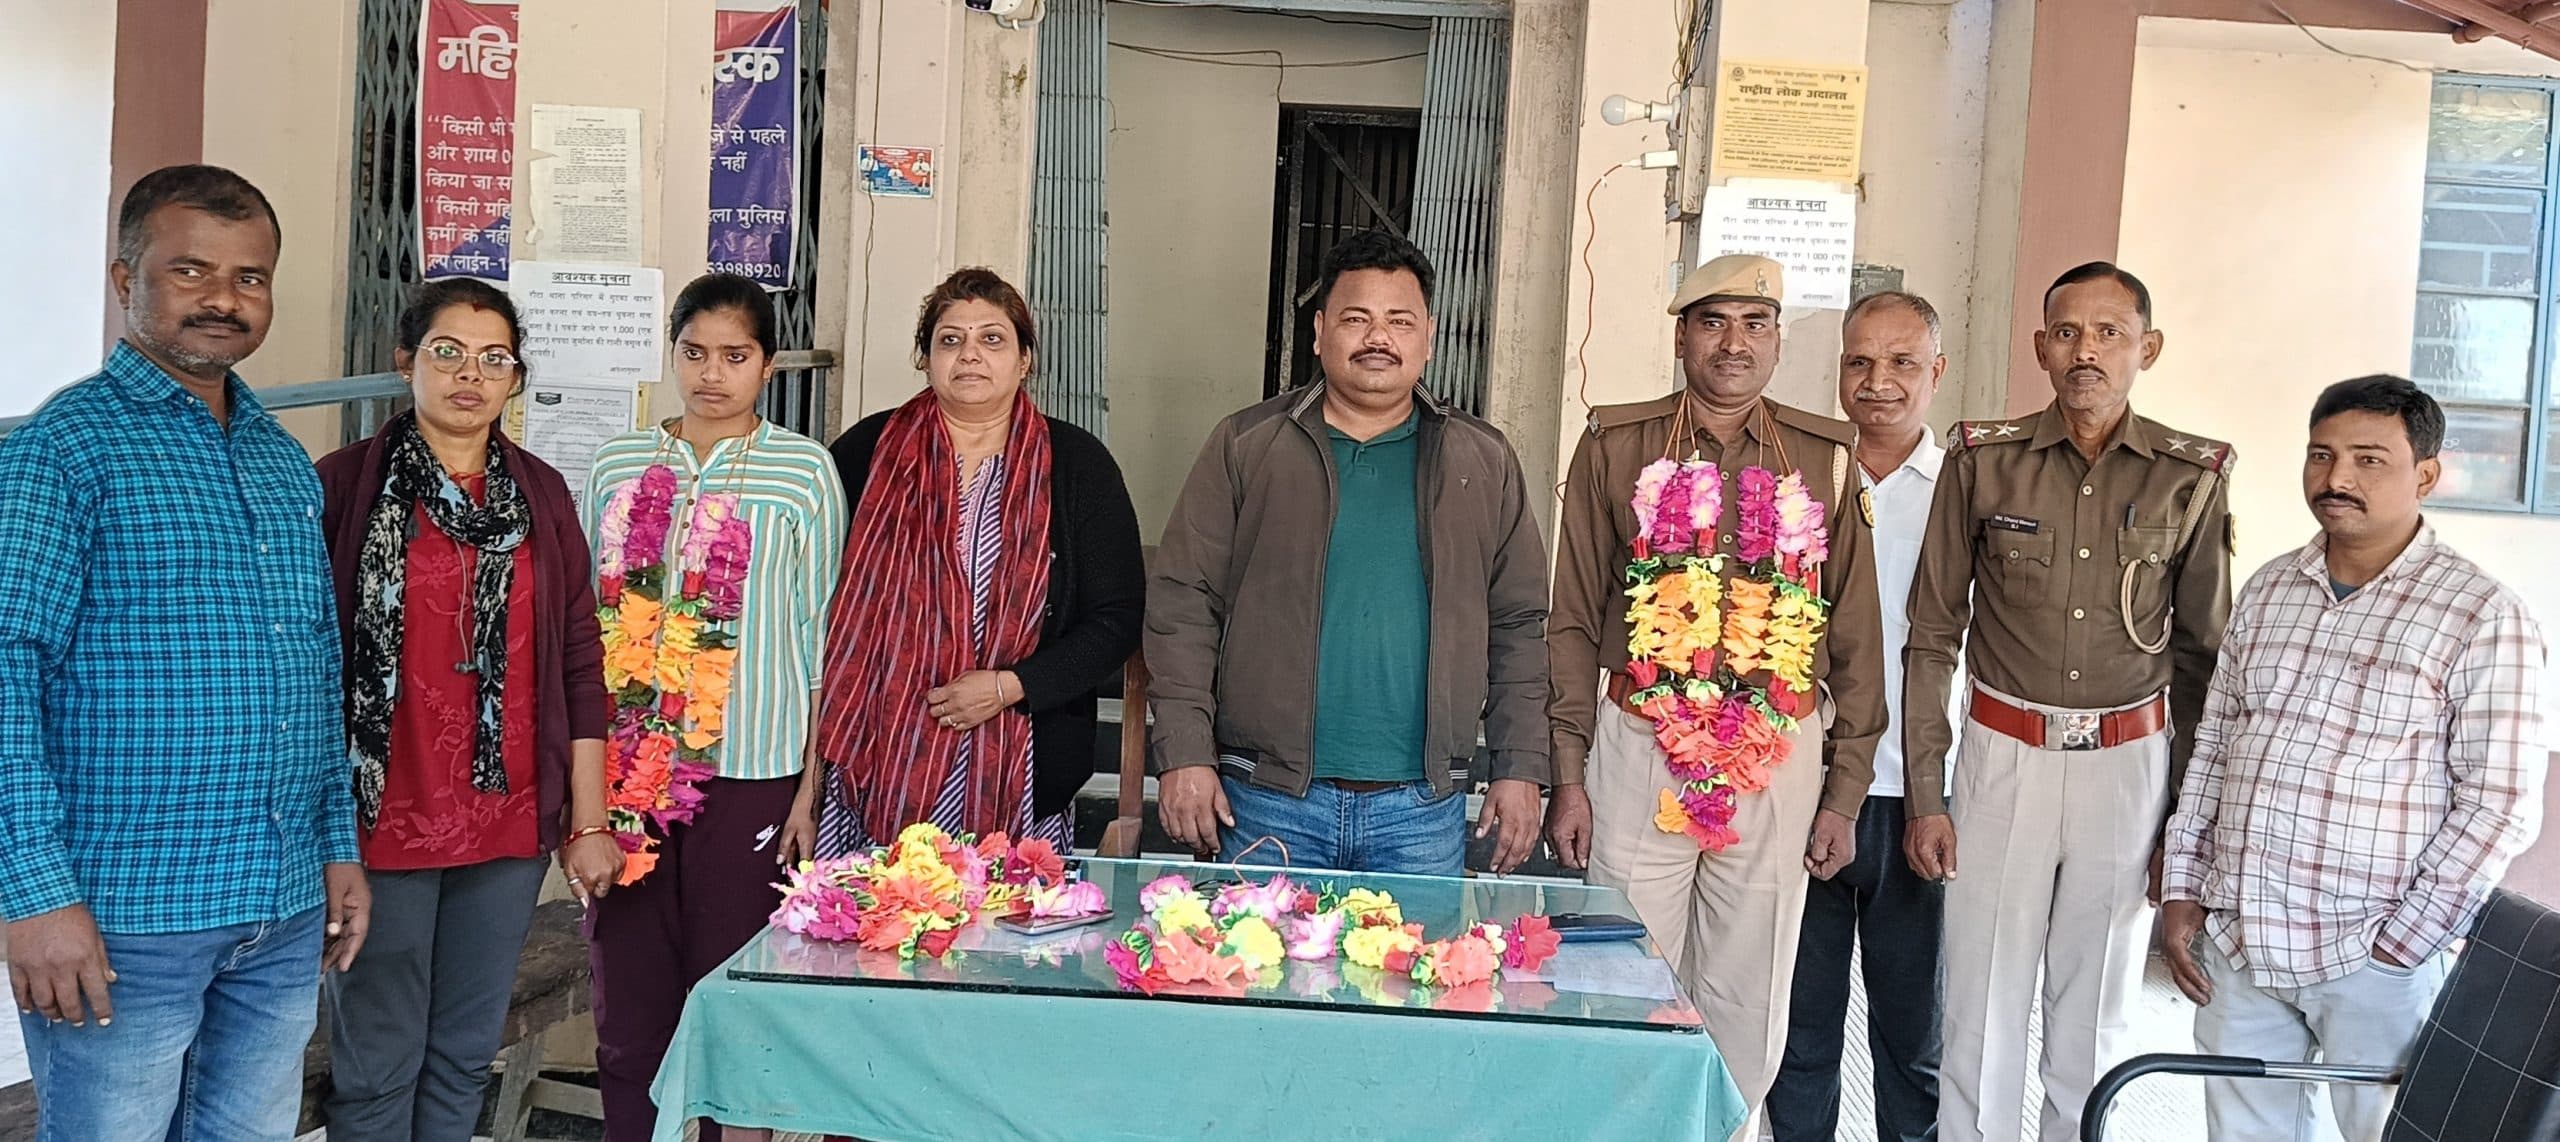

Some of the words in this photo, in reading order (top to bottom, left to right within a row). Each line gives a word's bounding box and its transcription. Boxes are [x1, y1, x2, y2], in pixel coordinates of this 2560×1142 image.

[438, 25, 518, 80] महि
[714, 47, 784, 82] स्क
[1739, 84, 1772, 97] राष्ट्रीय
[1776, 86, 1801, 97] लोक
[1806, 90, 1848, 100] अदालत
[489, 117, 506, 136] भी
[711, 123, 725, 143] जे
[730, 124, 746, 144] से
[749, 124, 787, 145] पहले
[427, 140, 459, 161] और
[463, 147, 498, 164] शाम
[502, 149, 512, 164] 0
[719, 151, 748, 172] नहीं
[425, 168, 467, 188] किया
[470, 175, 493, 190] जा
[496, 176, 512, 191] स
[483, 198, 512, 219] महि
[709, 208, 733, 224] ला
[461, 223, 480, 243] के
[452, 250, 507, 274] लाईन-1
[552, 272, 597, 282] आवश्यक
